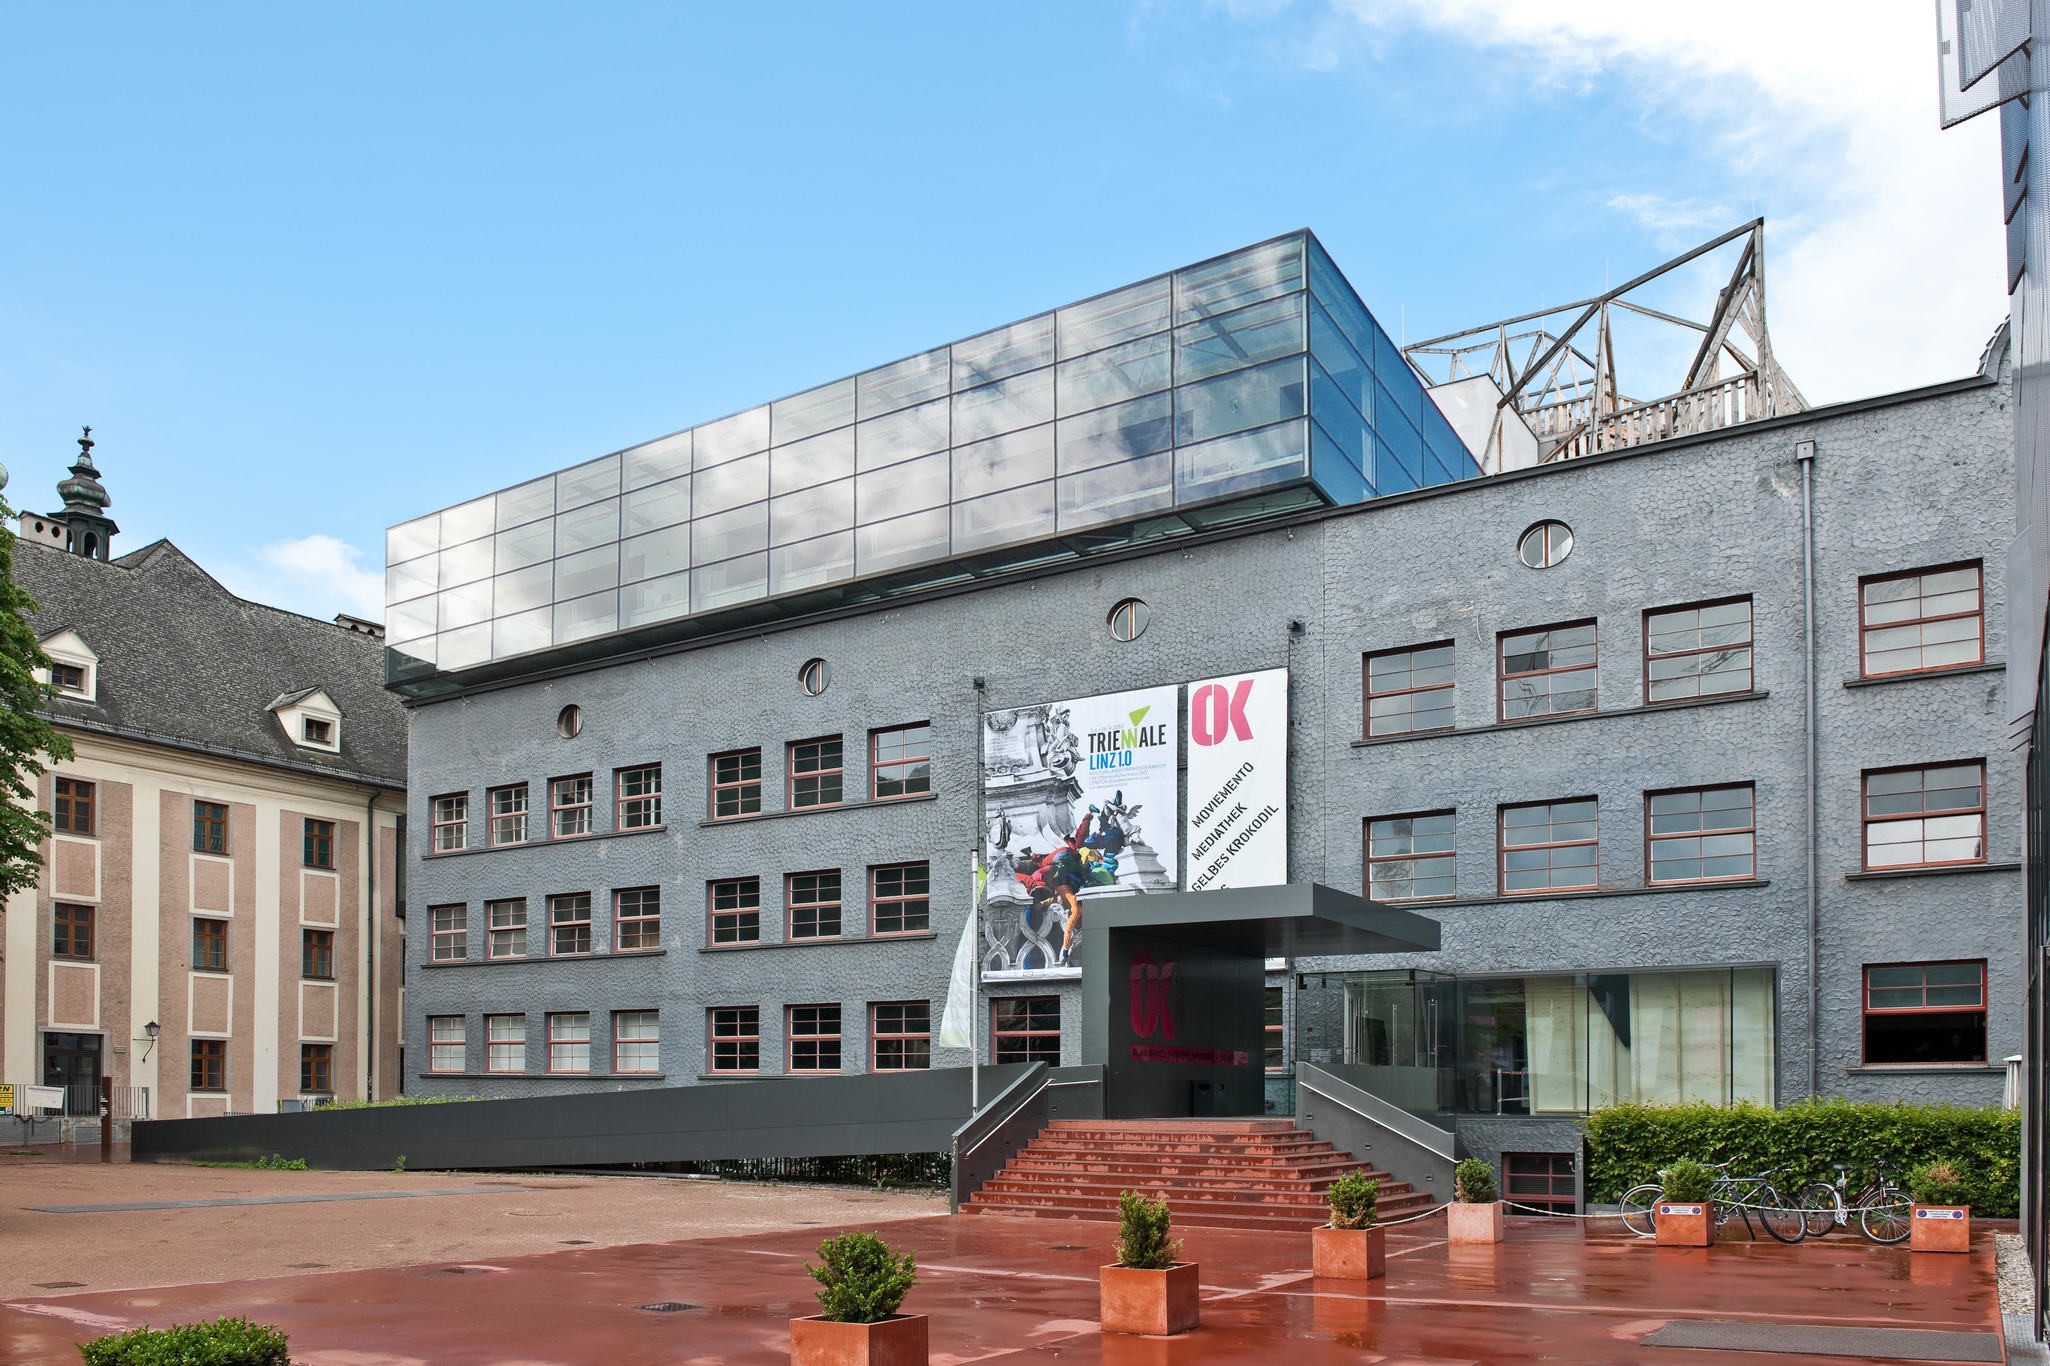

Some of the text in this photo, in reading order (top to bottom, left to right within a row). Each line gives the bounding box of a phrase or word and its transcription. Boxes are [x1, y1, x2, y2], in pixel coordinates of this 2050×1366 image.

[1088, 724, 1166, 753] TRIENNALE
[1191, 679, 1254, 747] OK
[1089, 750, 1132, 770] LINZ 1.0
[1191, 761, 1255, 829] MOVIEMENTO
[1191, 802, 1248, 861] MEDIATHEK
[1191, 805, 1280, 892] GELBES KROKODIL
[1130, 951, 1175, 1041] OK
